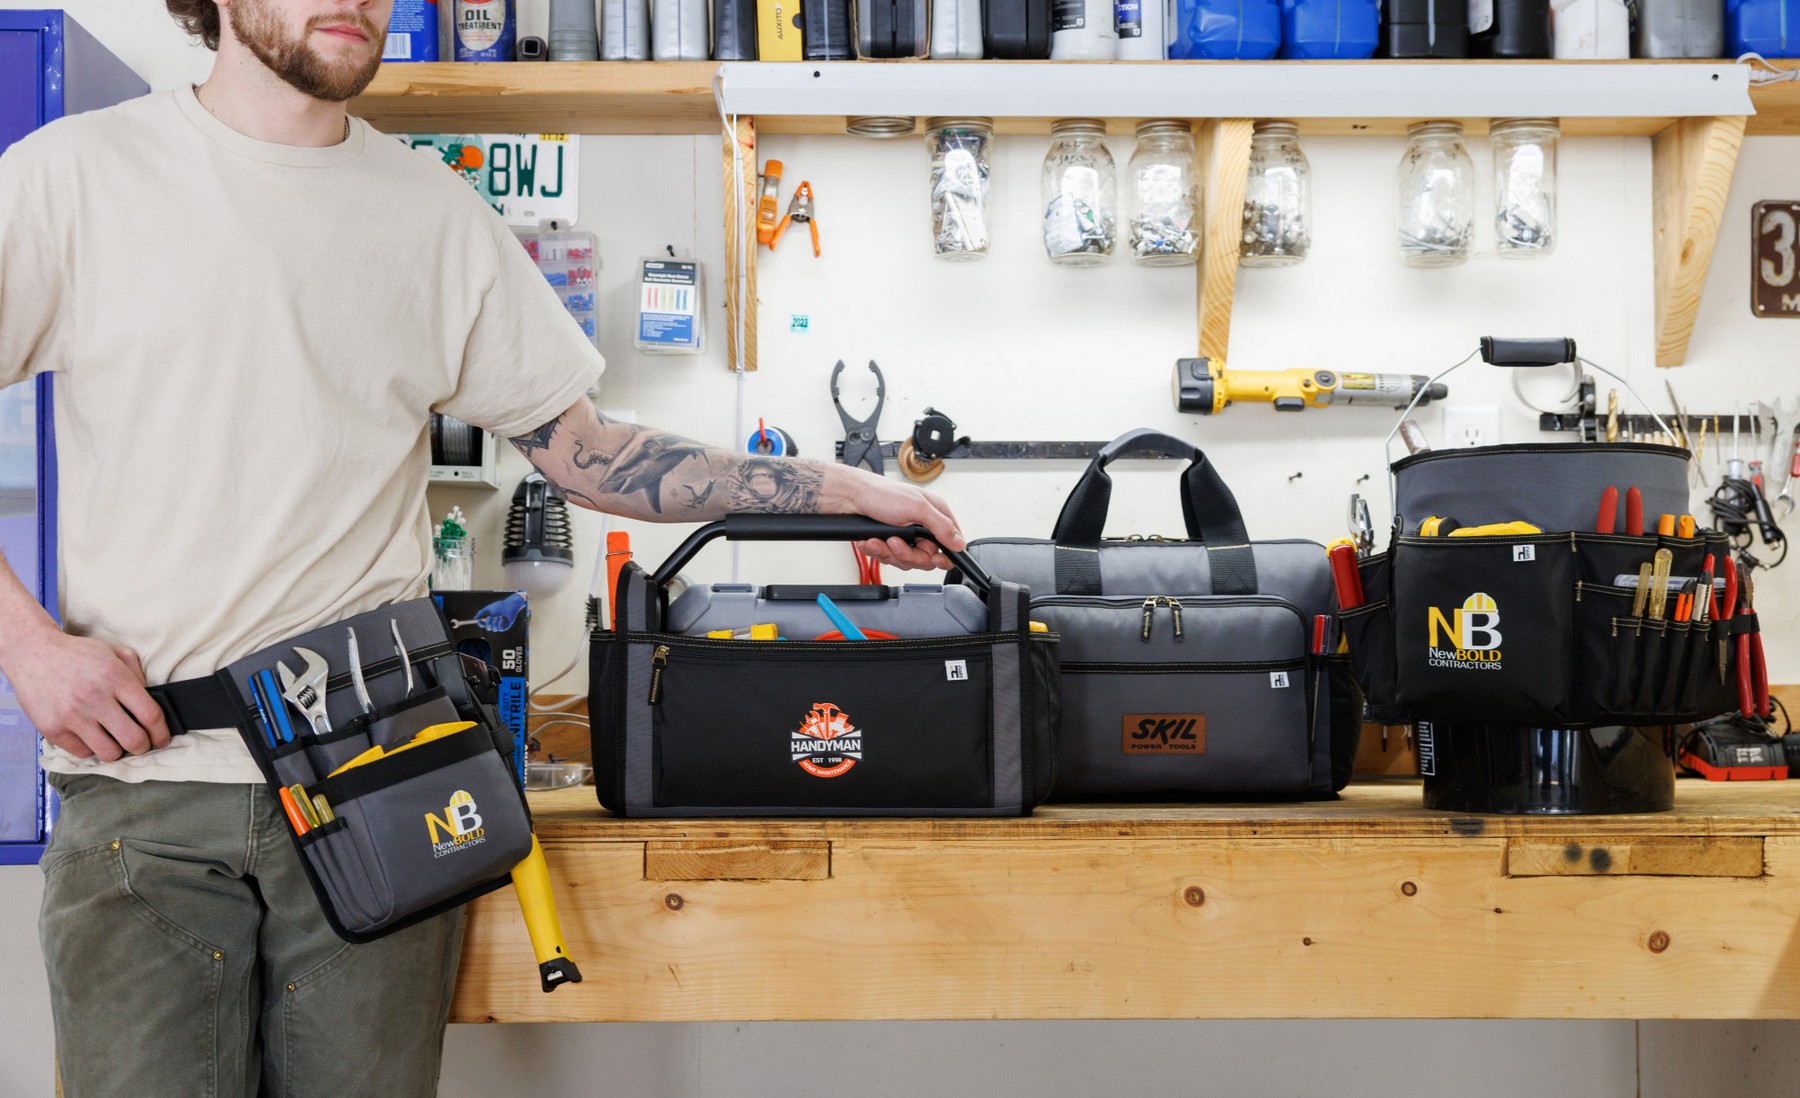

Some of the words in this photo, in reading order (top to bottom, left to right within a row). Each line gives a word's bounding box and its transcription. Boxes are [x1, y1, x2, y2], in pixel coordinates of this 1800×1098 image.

[465, 10, 491, 20] OIL
[459, 22, 502, 30] TREATMENT
[488, 143, 563, 197] 8WJ
[1761, 210, 1800, 287] 3
[502, 649, 516, 670] 50
[515, 646, 523, 673] GLOVES
[1429, 647, 1502, 662] NewBOLD
[1429, 659, 1502, 670] CONTRACTORS
[510, 682, 521, 738] NITRILE
[1131, 719, 1197, 745] SKIL
[791, 740, 861, 752] HANDYMAN
[802, 760, 816, 772] HOME
[817, 760, 852, 775] MAINTENANCE
[433, 828, 485, 852] NewBOLD
[434, 837, 486, 858] CONTRACTORS
